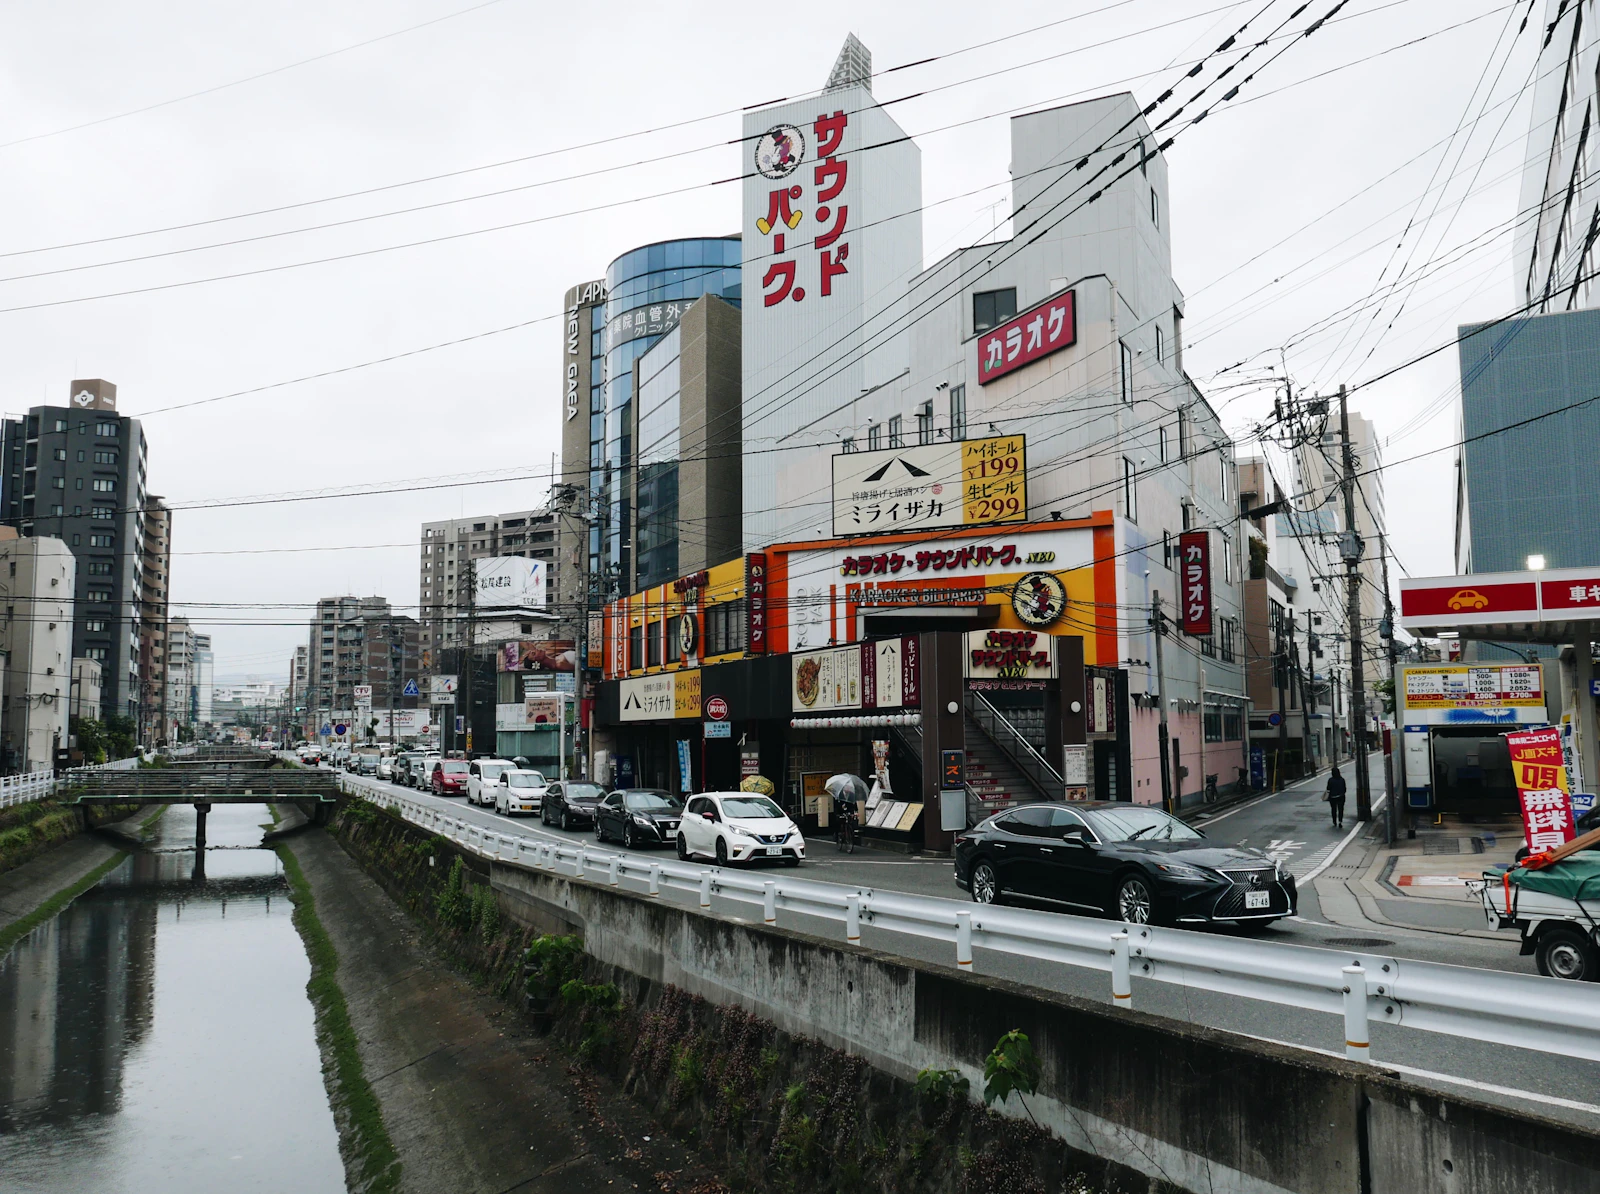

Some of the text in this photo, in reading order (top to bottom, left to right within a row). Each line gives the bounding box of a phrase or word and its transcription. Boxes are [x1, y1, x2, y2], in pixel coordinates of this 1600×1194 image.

[814, 110, 849, 296] サウンド
[985, 306, 1066, 372] カラオケ
[567, 362, 579, 421] GAEA
[967, 441, 1018, 459] ハイボール
[968, 480, 1019, 500] 生ビール
[852, 499, 943, 524] ミライザカ
[1186, 545, 1205, 622] カラオケ
[752, 581, 763, 642] カラオケ
[986, 631, 1038, 649] カラオケ
[644, 695, 671, 713] ミライザカ
